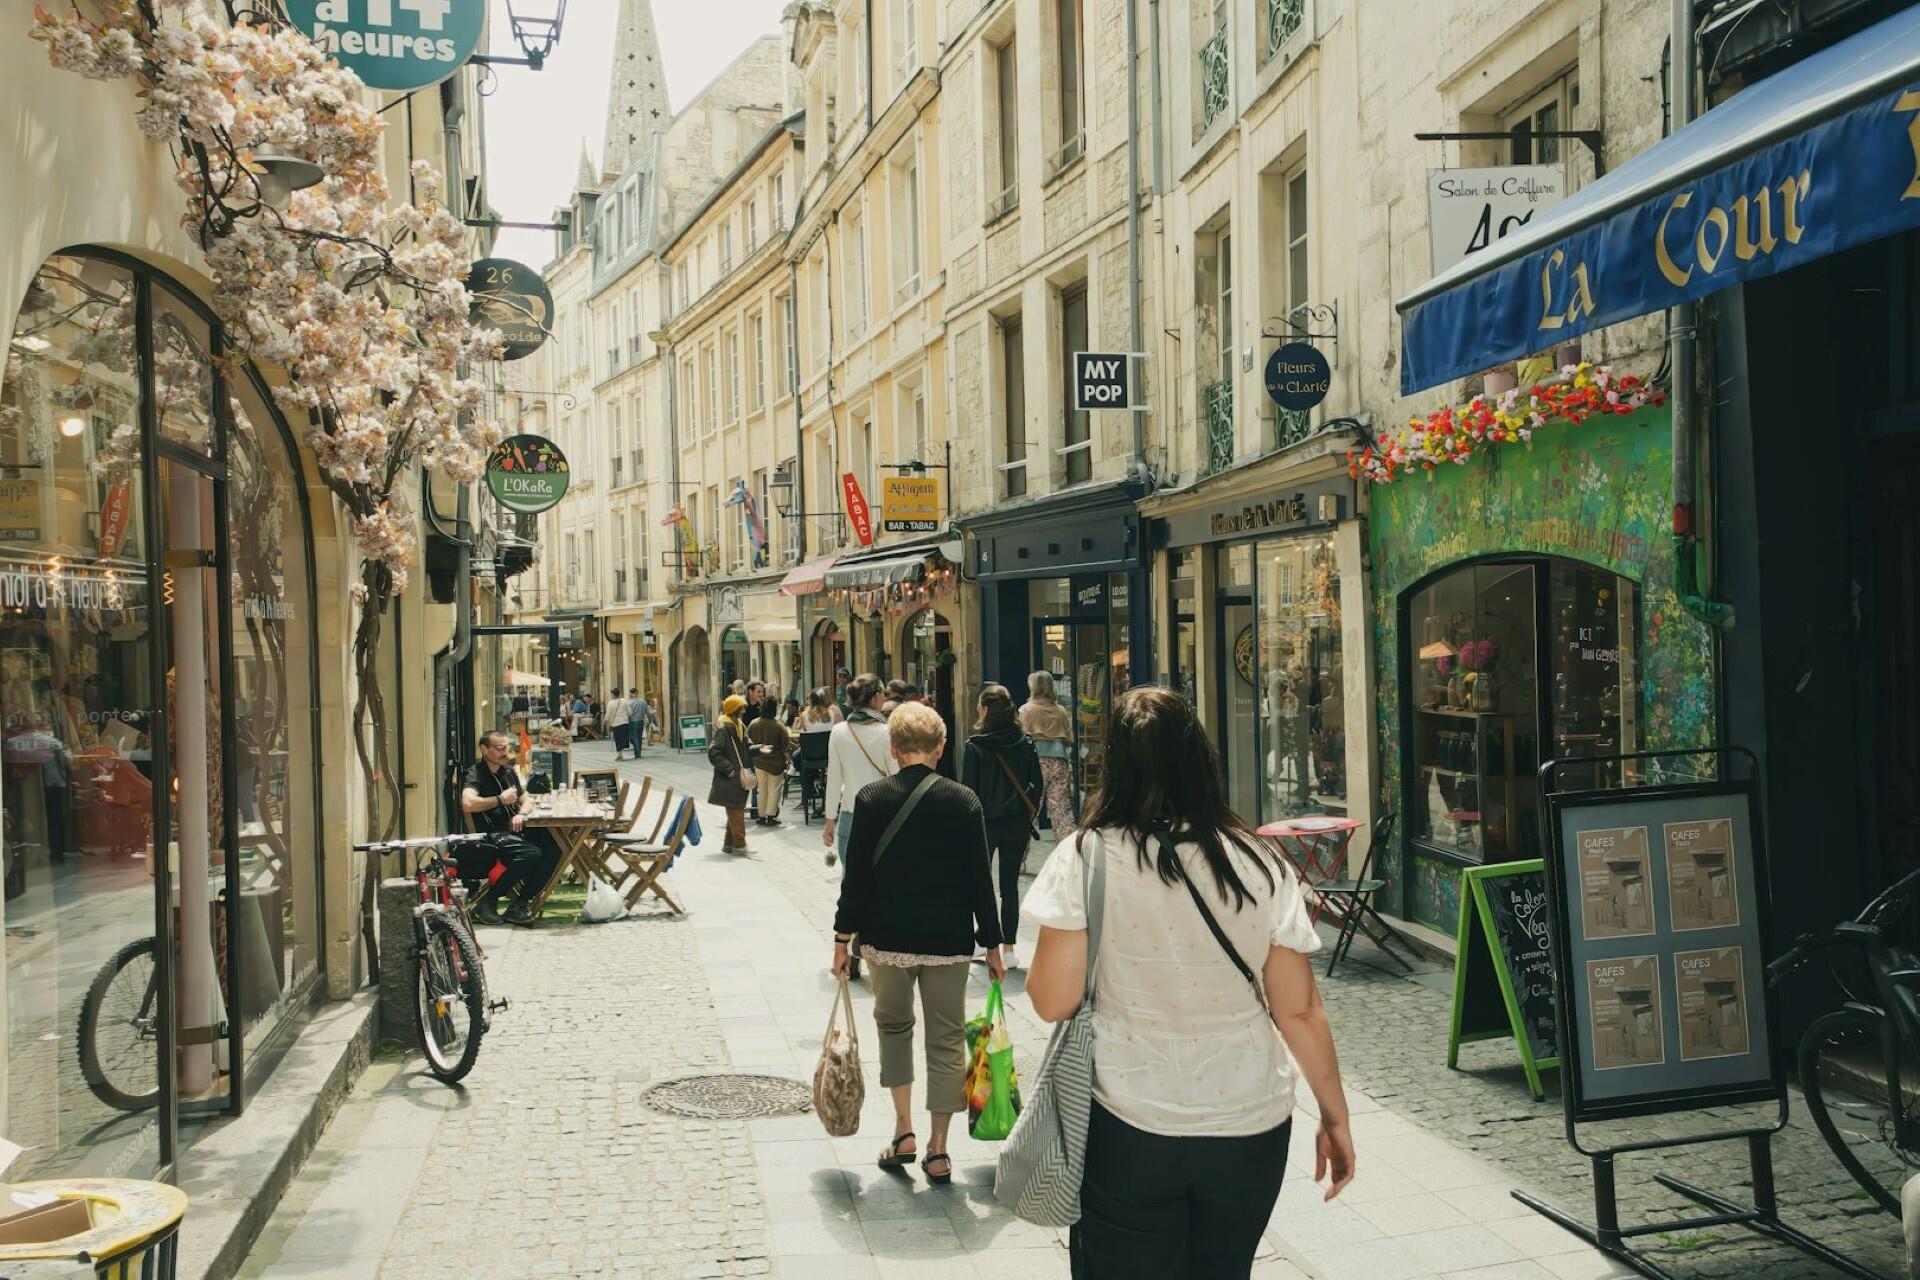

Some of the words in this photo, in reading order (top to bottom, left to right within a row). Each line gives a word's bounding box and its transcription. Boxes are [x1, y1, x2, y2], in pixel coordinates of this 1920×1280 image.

[314, 22, 456, 62] heures
[1438, 179, 1480, 198] Salon
[1484, 180, 1497, 196] de
[1501, 177, 1556, 202] Coiffure
[1538, 249, 1596, 330] La
[1655, 168, 1811, 288] Cour
[486, 267, 513, 284] 26
[1084, 360, 1121, 380] MY
[1277, 361, 1317, 374] Fleurs
[1084, 384, 1122, 402] POP
[846, 481, 869, 537] TABAC
[888, 521, 905, 531] BAR
[911, 521, 935, 531] TABAC
